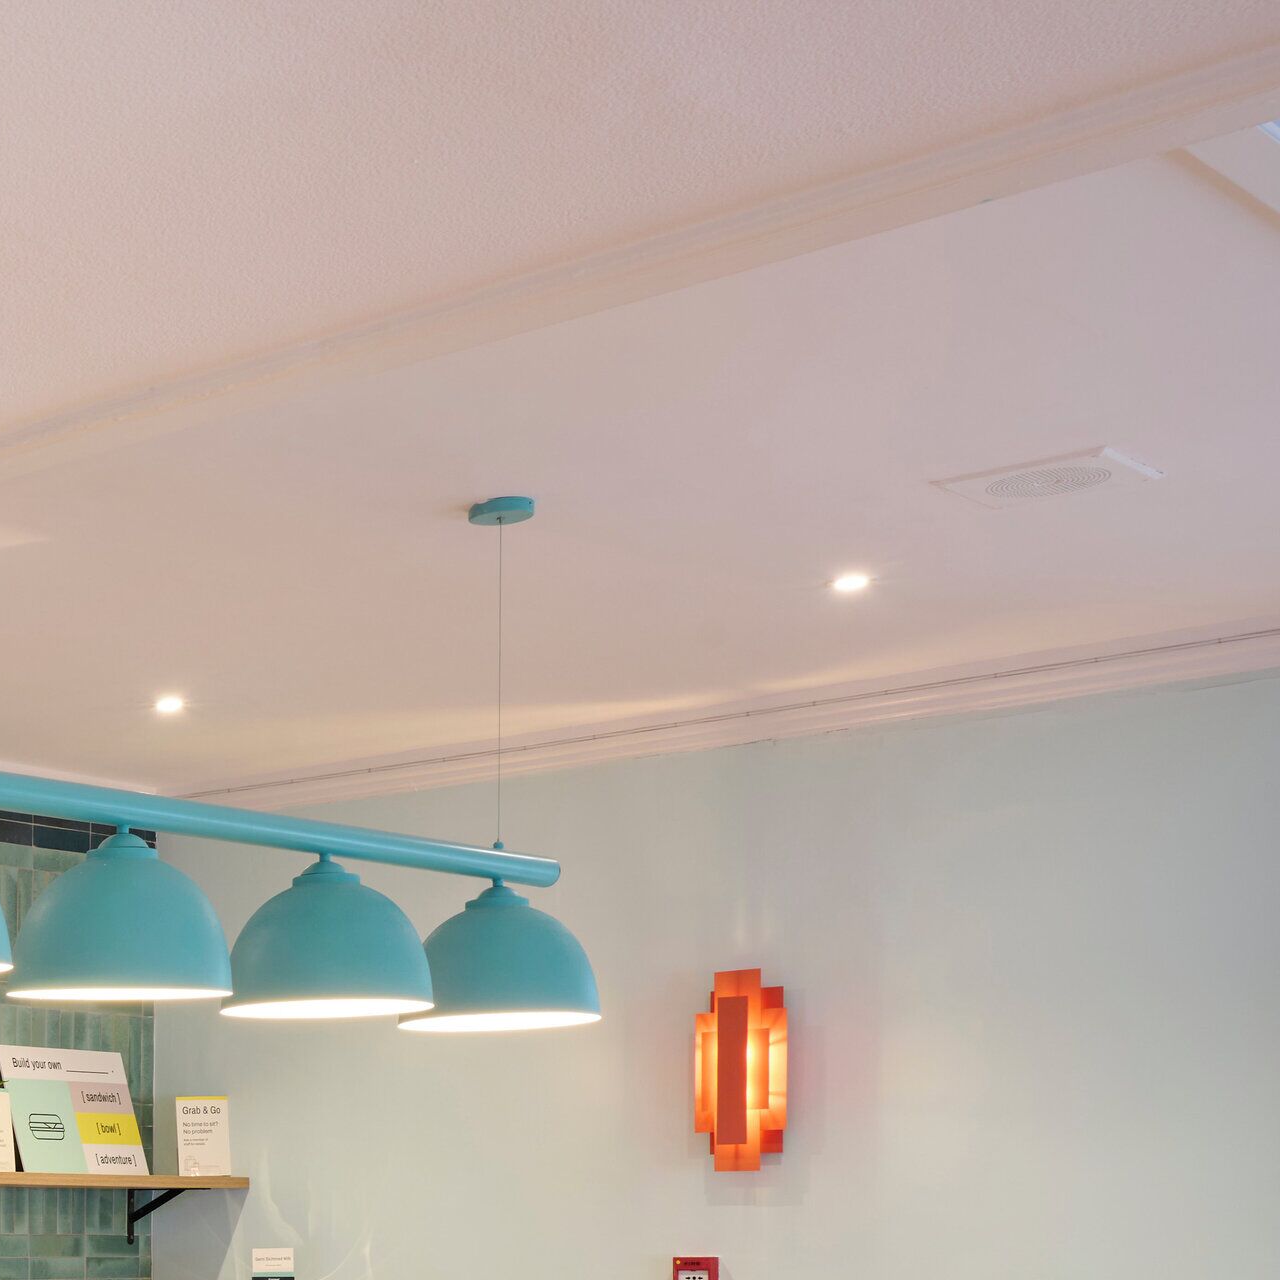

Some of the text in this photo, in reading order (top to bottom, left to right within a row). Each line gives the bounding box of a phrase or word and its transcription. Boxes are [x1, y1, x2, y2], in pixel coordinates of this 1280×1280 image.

[11, 1057, 62, 1071] Build your own
[86, 1092, 116, 1103] sandwich
[182, 1106, 221, 1115] Grab & Go
[101, 1123, 116, 1134] bowl
[100, 1155, 132, 1165] adventure
